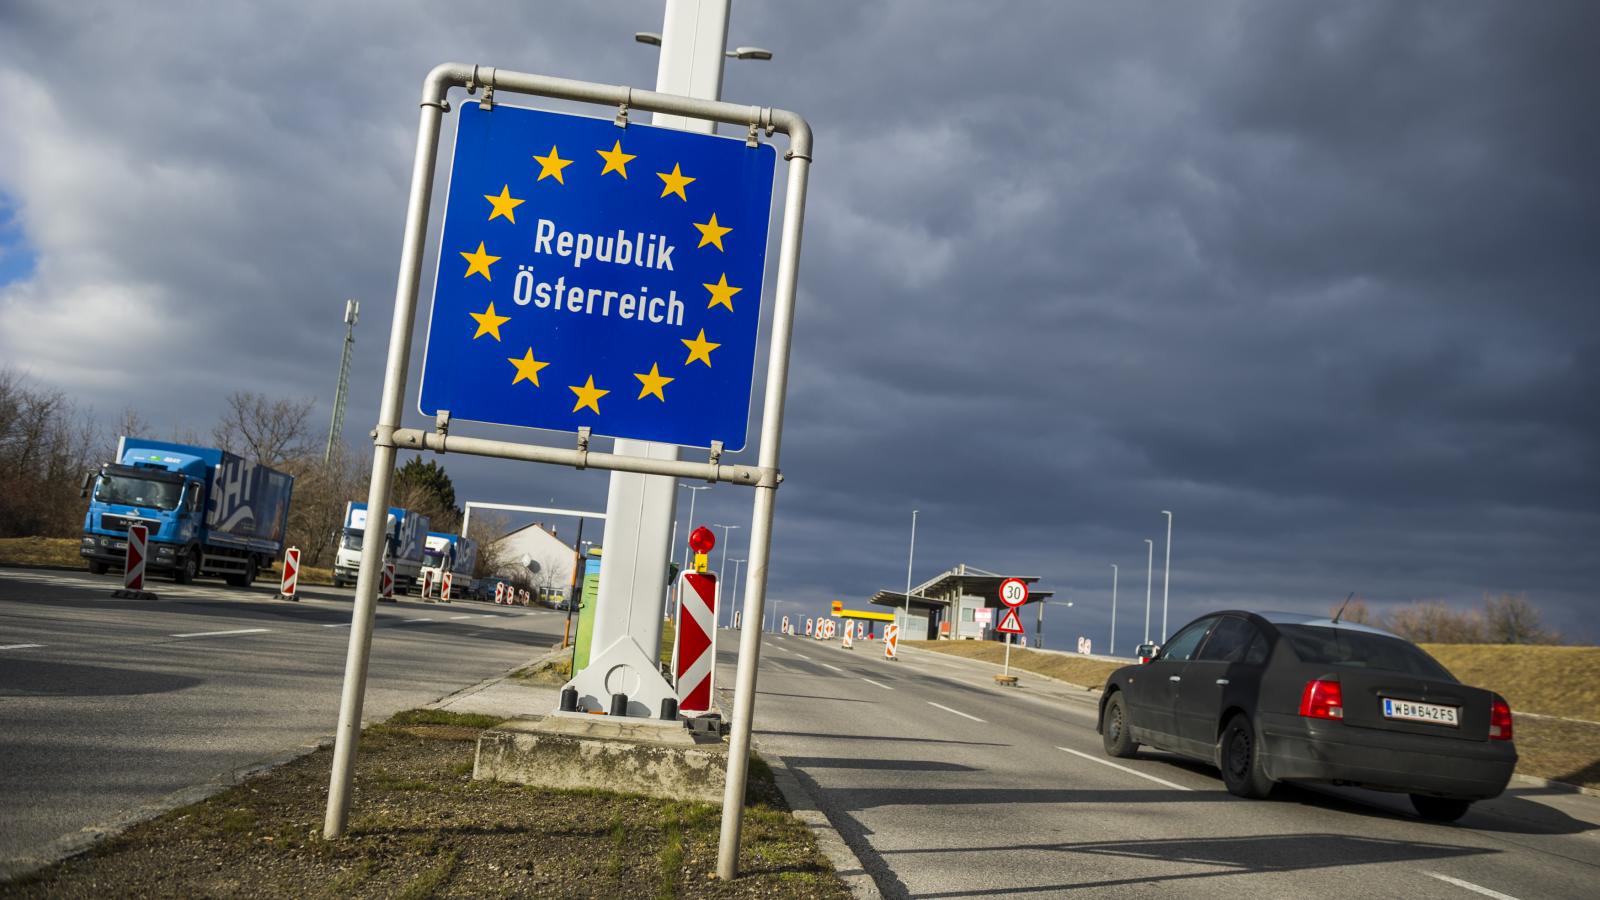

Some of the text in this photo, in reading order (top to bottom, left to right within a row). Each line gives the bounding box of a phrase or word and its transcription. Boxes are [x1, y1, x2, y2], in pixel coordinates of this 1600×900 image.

[534, 218, 676, 271] Republik
[513, 264, 685, 326] Österreich
[1006, 585, 1021, 600] 30
[1418, 706, 1454, 721] 642FS
